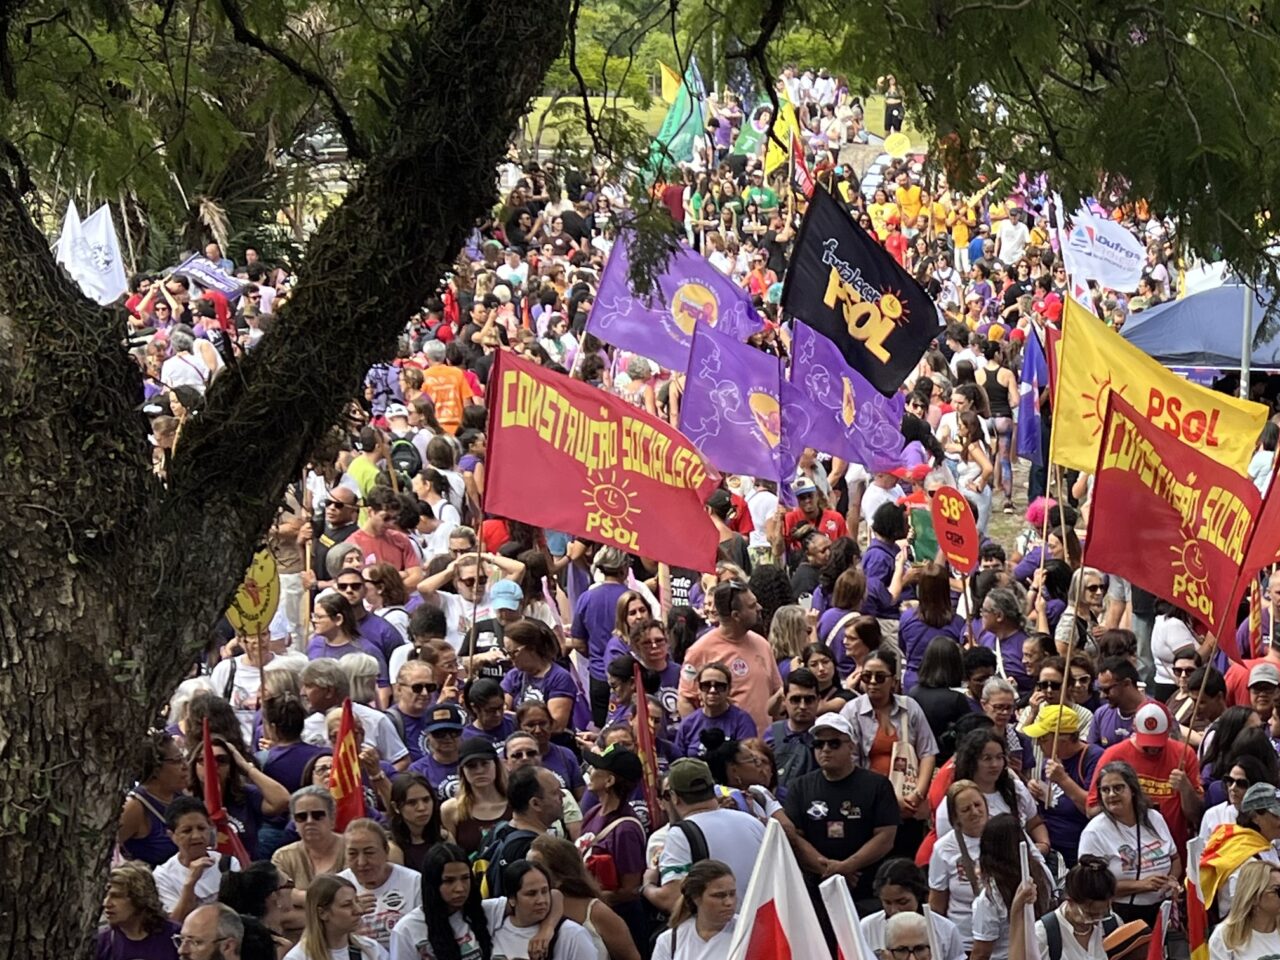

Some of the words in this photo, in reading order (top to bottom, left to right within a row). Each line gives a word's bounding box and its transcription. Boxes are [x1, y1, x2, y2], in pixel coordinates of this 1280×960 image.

[501, 369, 618, 477] CONSTRUÇÃO
[1145, 386, 1221, 447] PSOL
[585, 511, 640, 551] PSOL
[1172, 573, 1215, 625] PSOL
